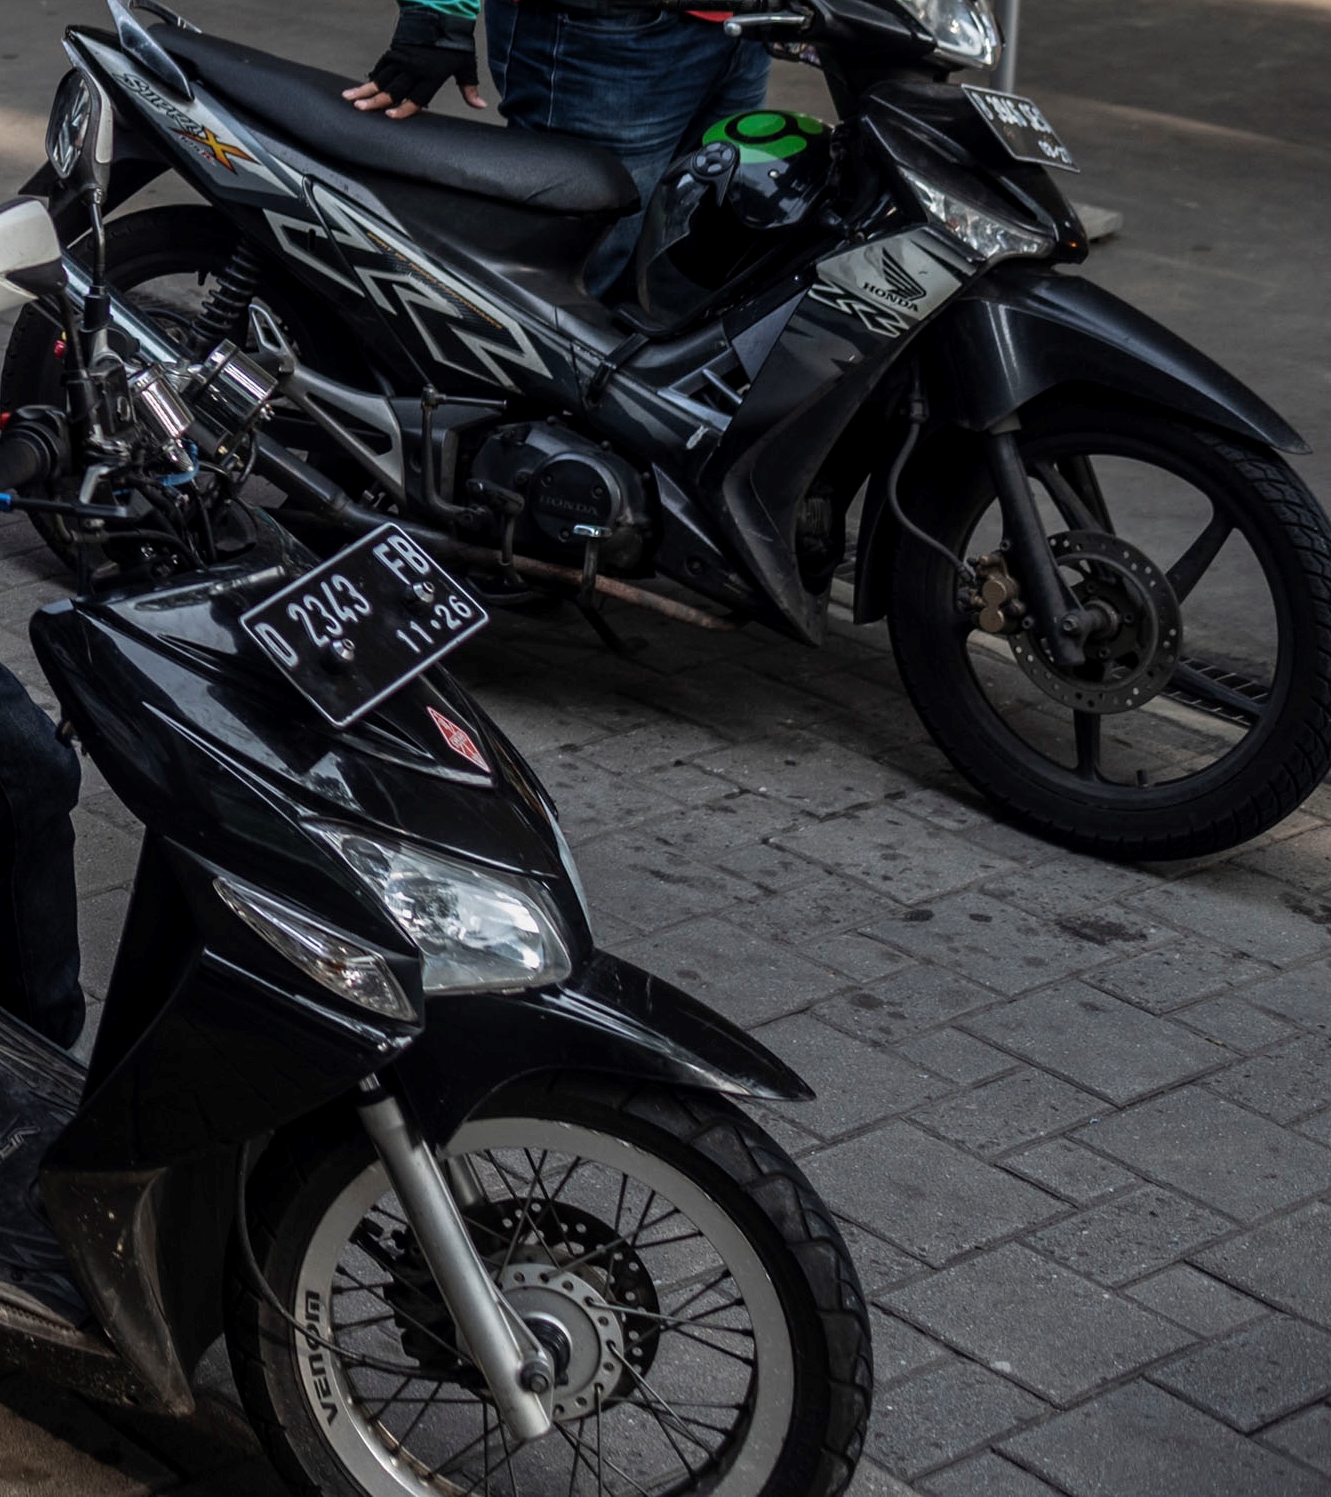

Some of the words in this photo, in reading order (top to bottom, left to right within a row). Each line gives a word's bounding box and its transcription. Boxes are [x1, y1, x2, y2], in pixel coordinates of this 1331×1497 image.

[862, 281, 920, 313] HONDA
[254, 622, 299, 669] D
[286, 573, 372, 648] 2343
[373, 534, 431, 585] FB
